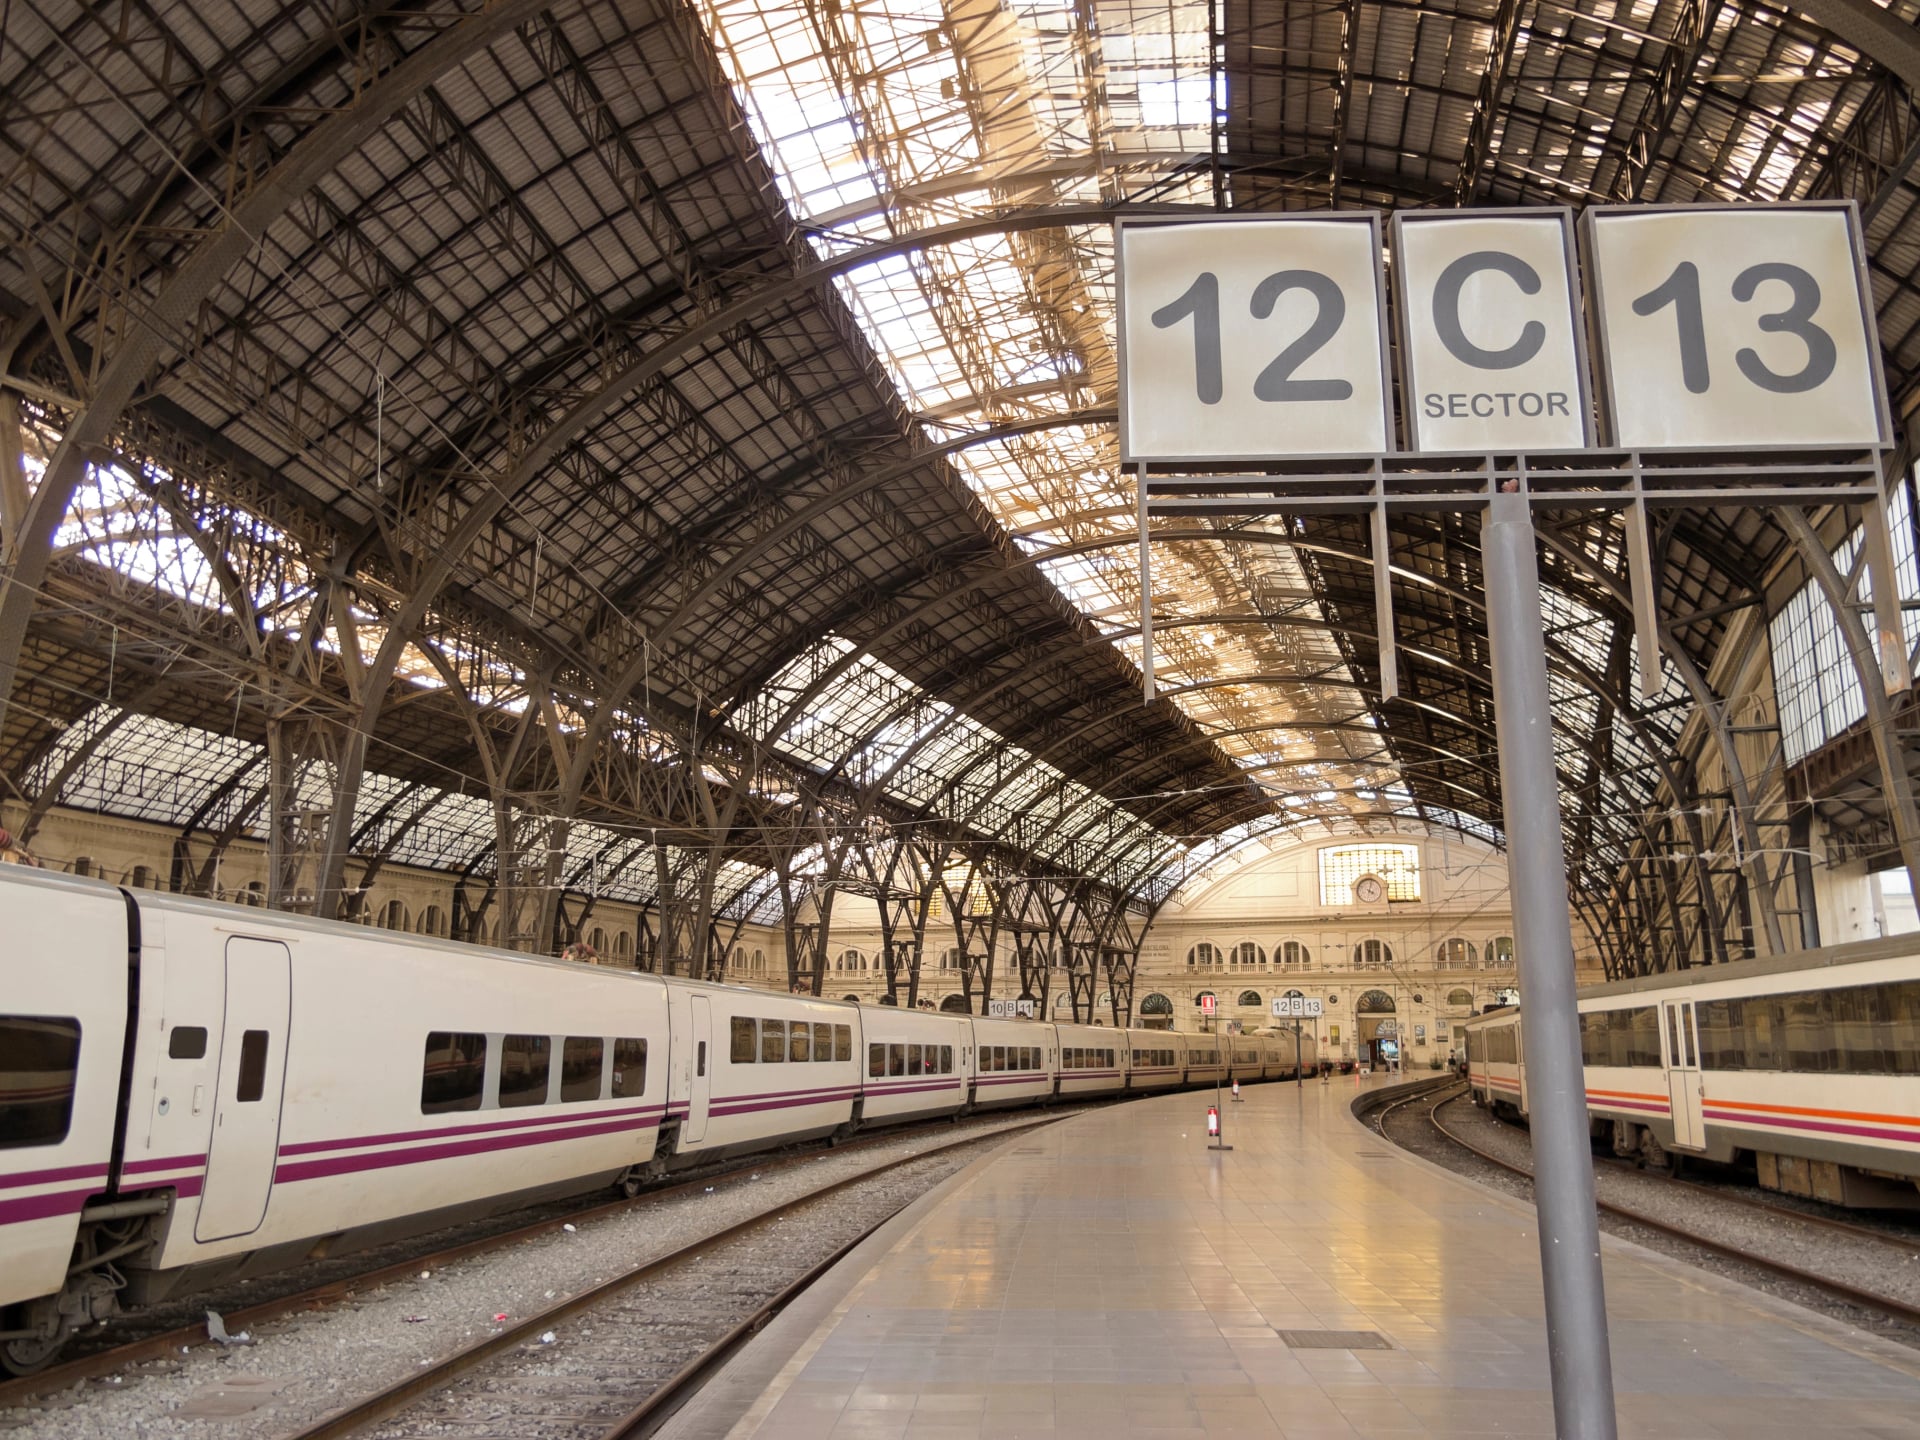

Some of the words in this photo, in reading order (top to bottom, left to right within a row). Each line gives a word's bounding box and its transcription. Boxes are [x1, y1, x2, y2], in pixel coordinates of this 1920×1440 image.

[1151, 270, 1353, 404] 12
[1432, 251, 1546, 369] C
[1632, 262, 1837, 393] 13
[1425, 392, 1570, 419] SECTOR
[991, 1003, 1003, 1014] 10
[1007, 1002, 1014, 1011] B
[1020, 1003, 1031, 1014] 11
[1274, 1001, 1288, 1012] 12
[1293, 1000, 1300, 1010] B
[1306, 1001, 1320, 1012] 13
